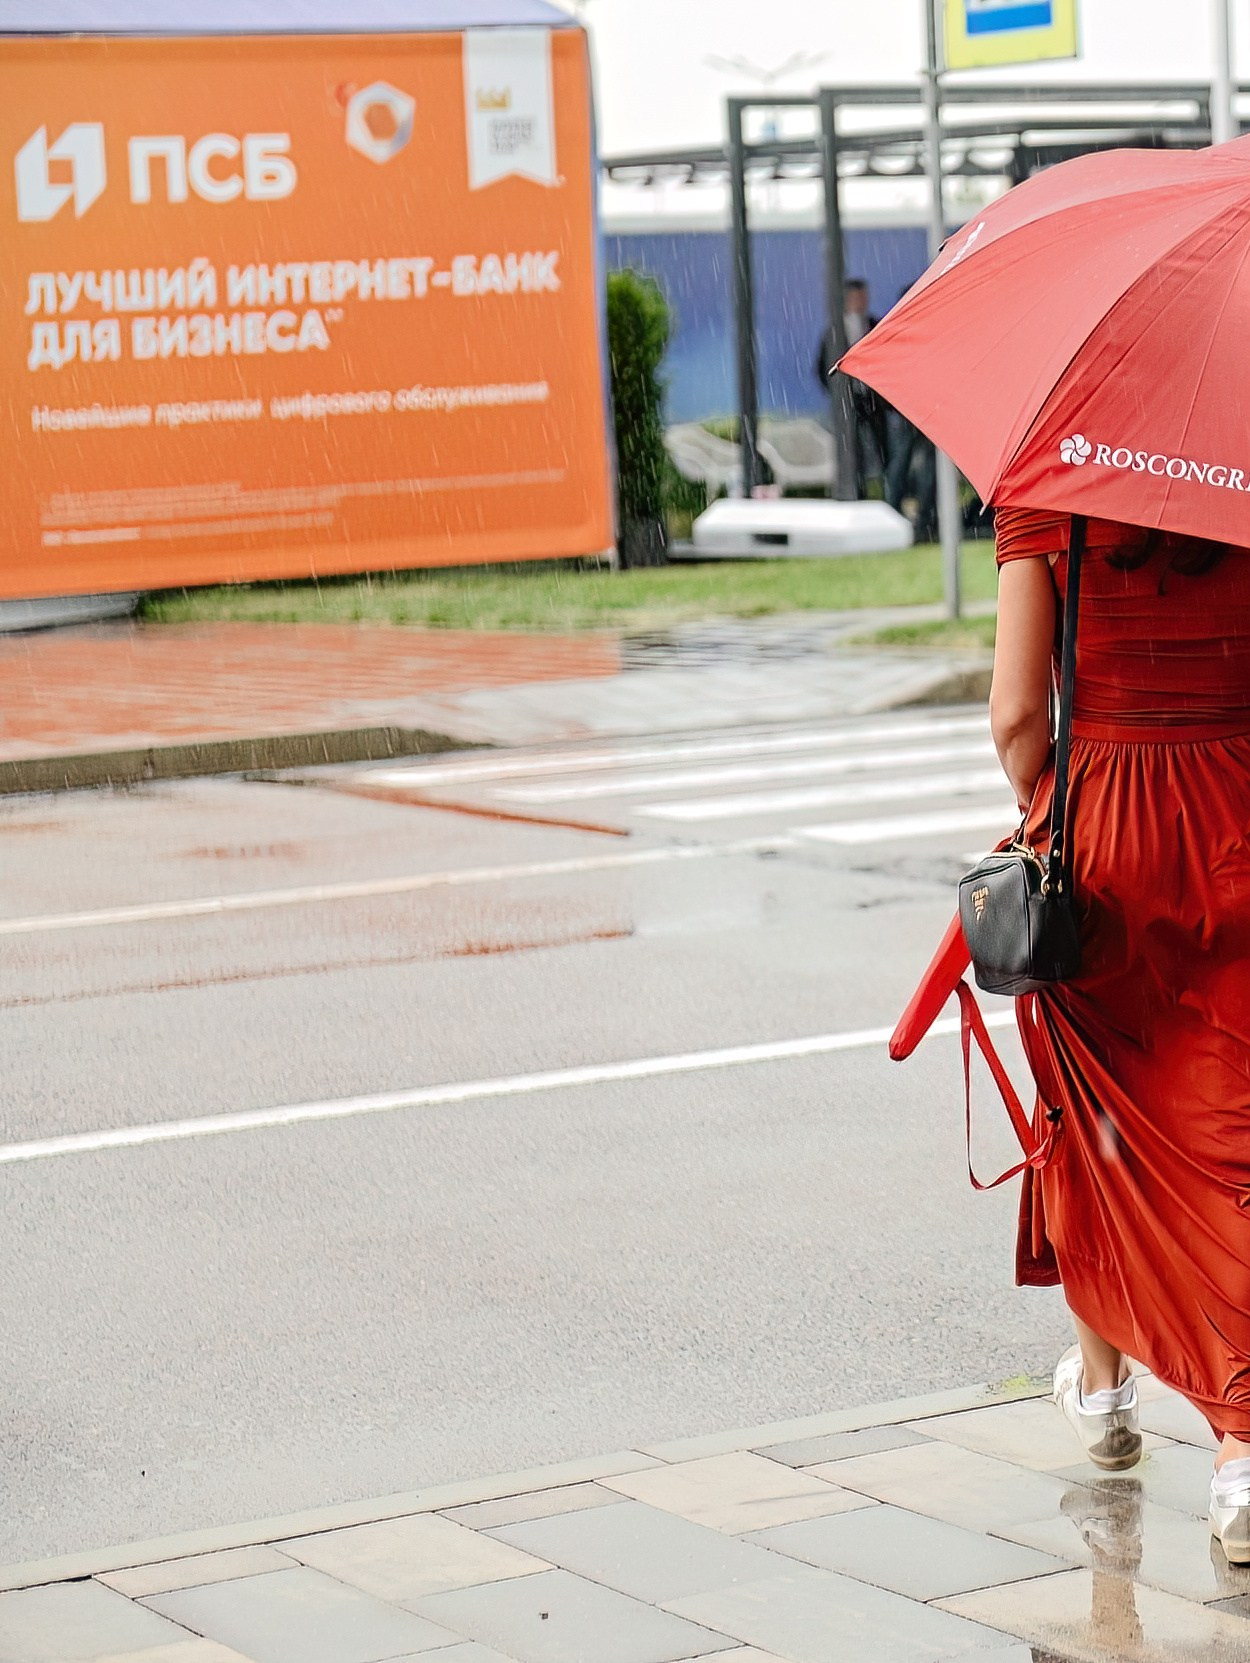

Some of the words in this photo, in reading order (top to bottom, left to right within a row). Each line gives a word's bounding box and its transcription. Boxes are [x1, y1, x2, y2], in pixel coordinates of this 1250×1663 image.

[128, 133, 297, 204] ПСБ
[25, 257, 216, 315] ЛУЧШИЙ
[227, 250, 560, 307] ИНТЕРНЕТ-БАНК
[28, 319, 121, 371] ДЛЯ
[132, 308, 331, 359] БИЗНЕСА
